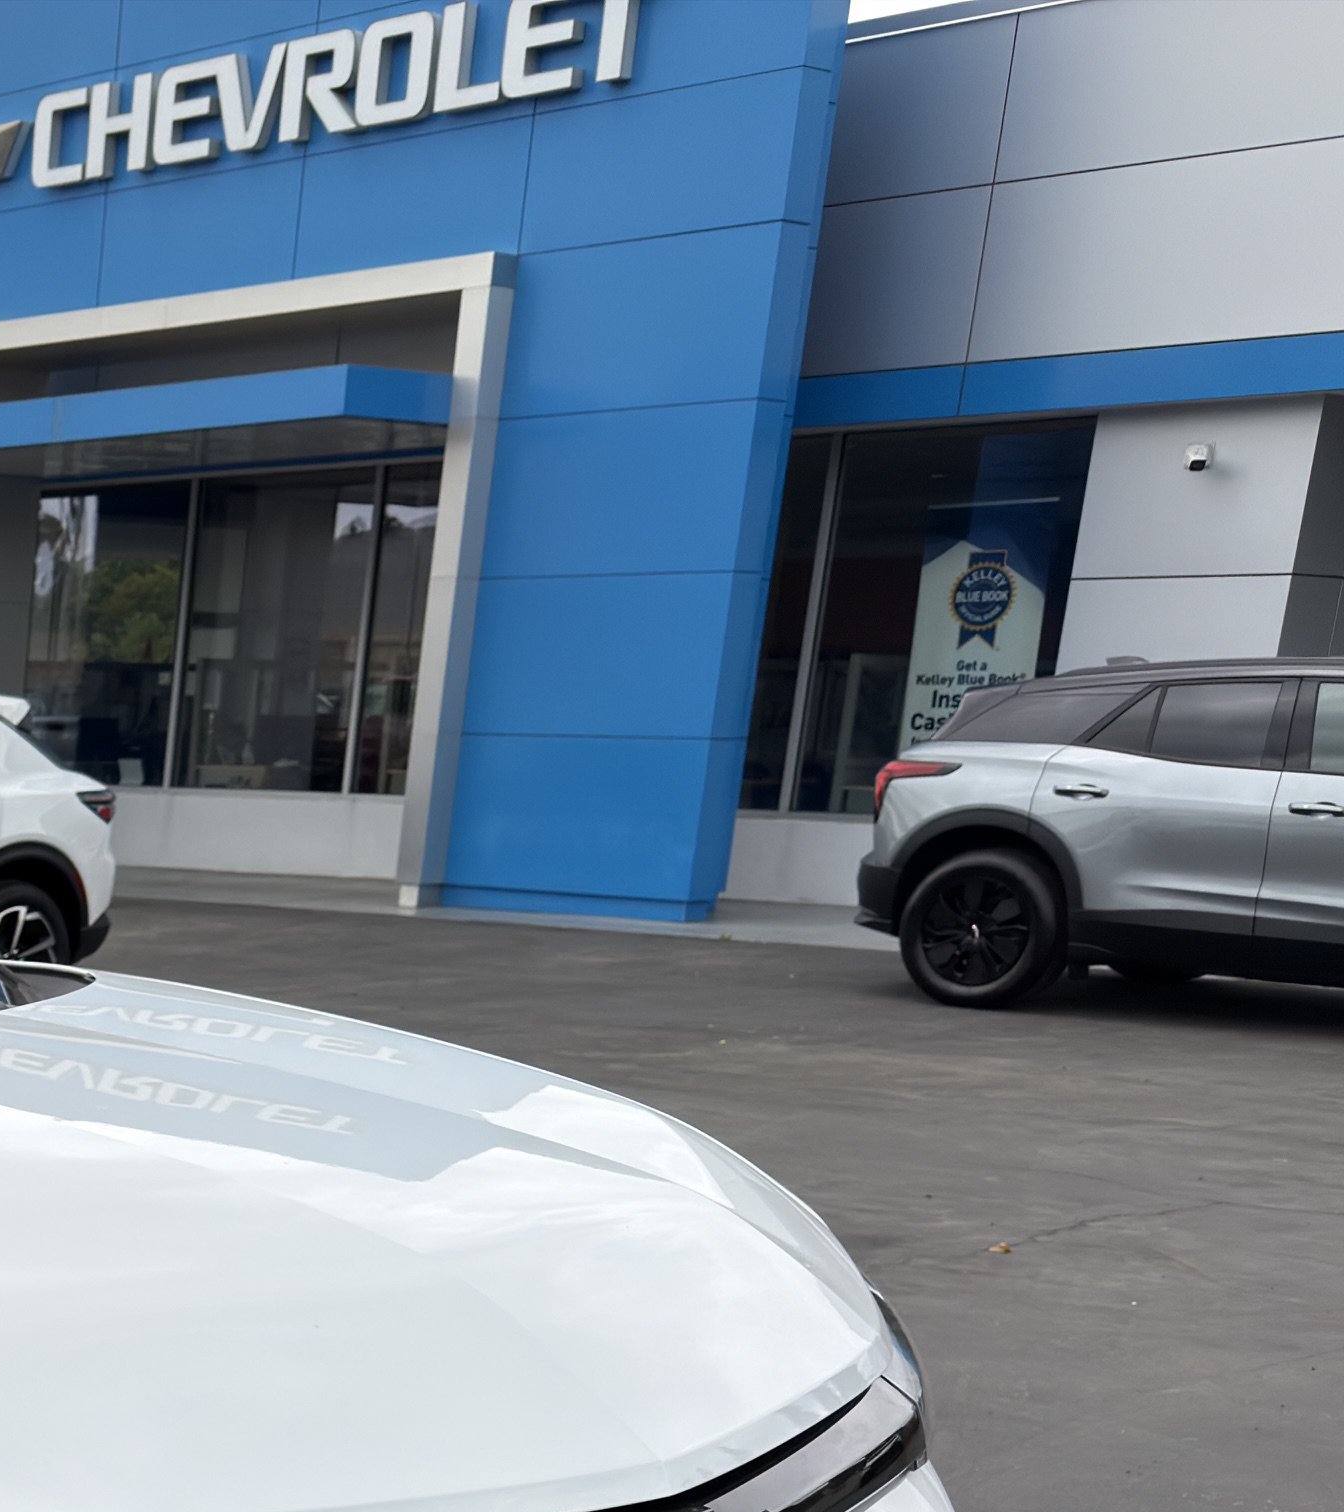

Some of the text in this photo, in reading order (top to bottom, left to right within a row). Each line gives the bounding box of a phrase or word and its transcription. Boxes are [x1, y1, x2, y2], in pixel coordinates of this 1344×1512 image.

[962, 569, 1007, 588] KELLEY
[955, 590, 1009, 603] BLUE BOOK
[956, 660, 988, 671] Get a
[915, 673, 954, 687] Kelley
[957, 674, 985, 685] Blue
[910, 713, 954, 731] Cas
